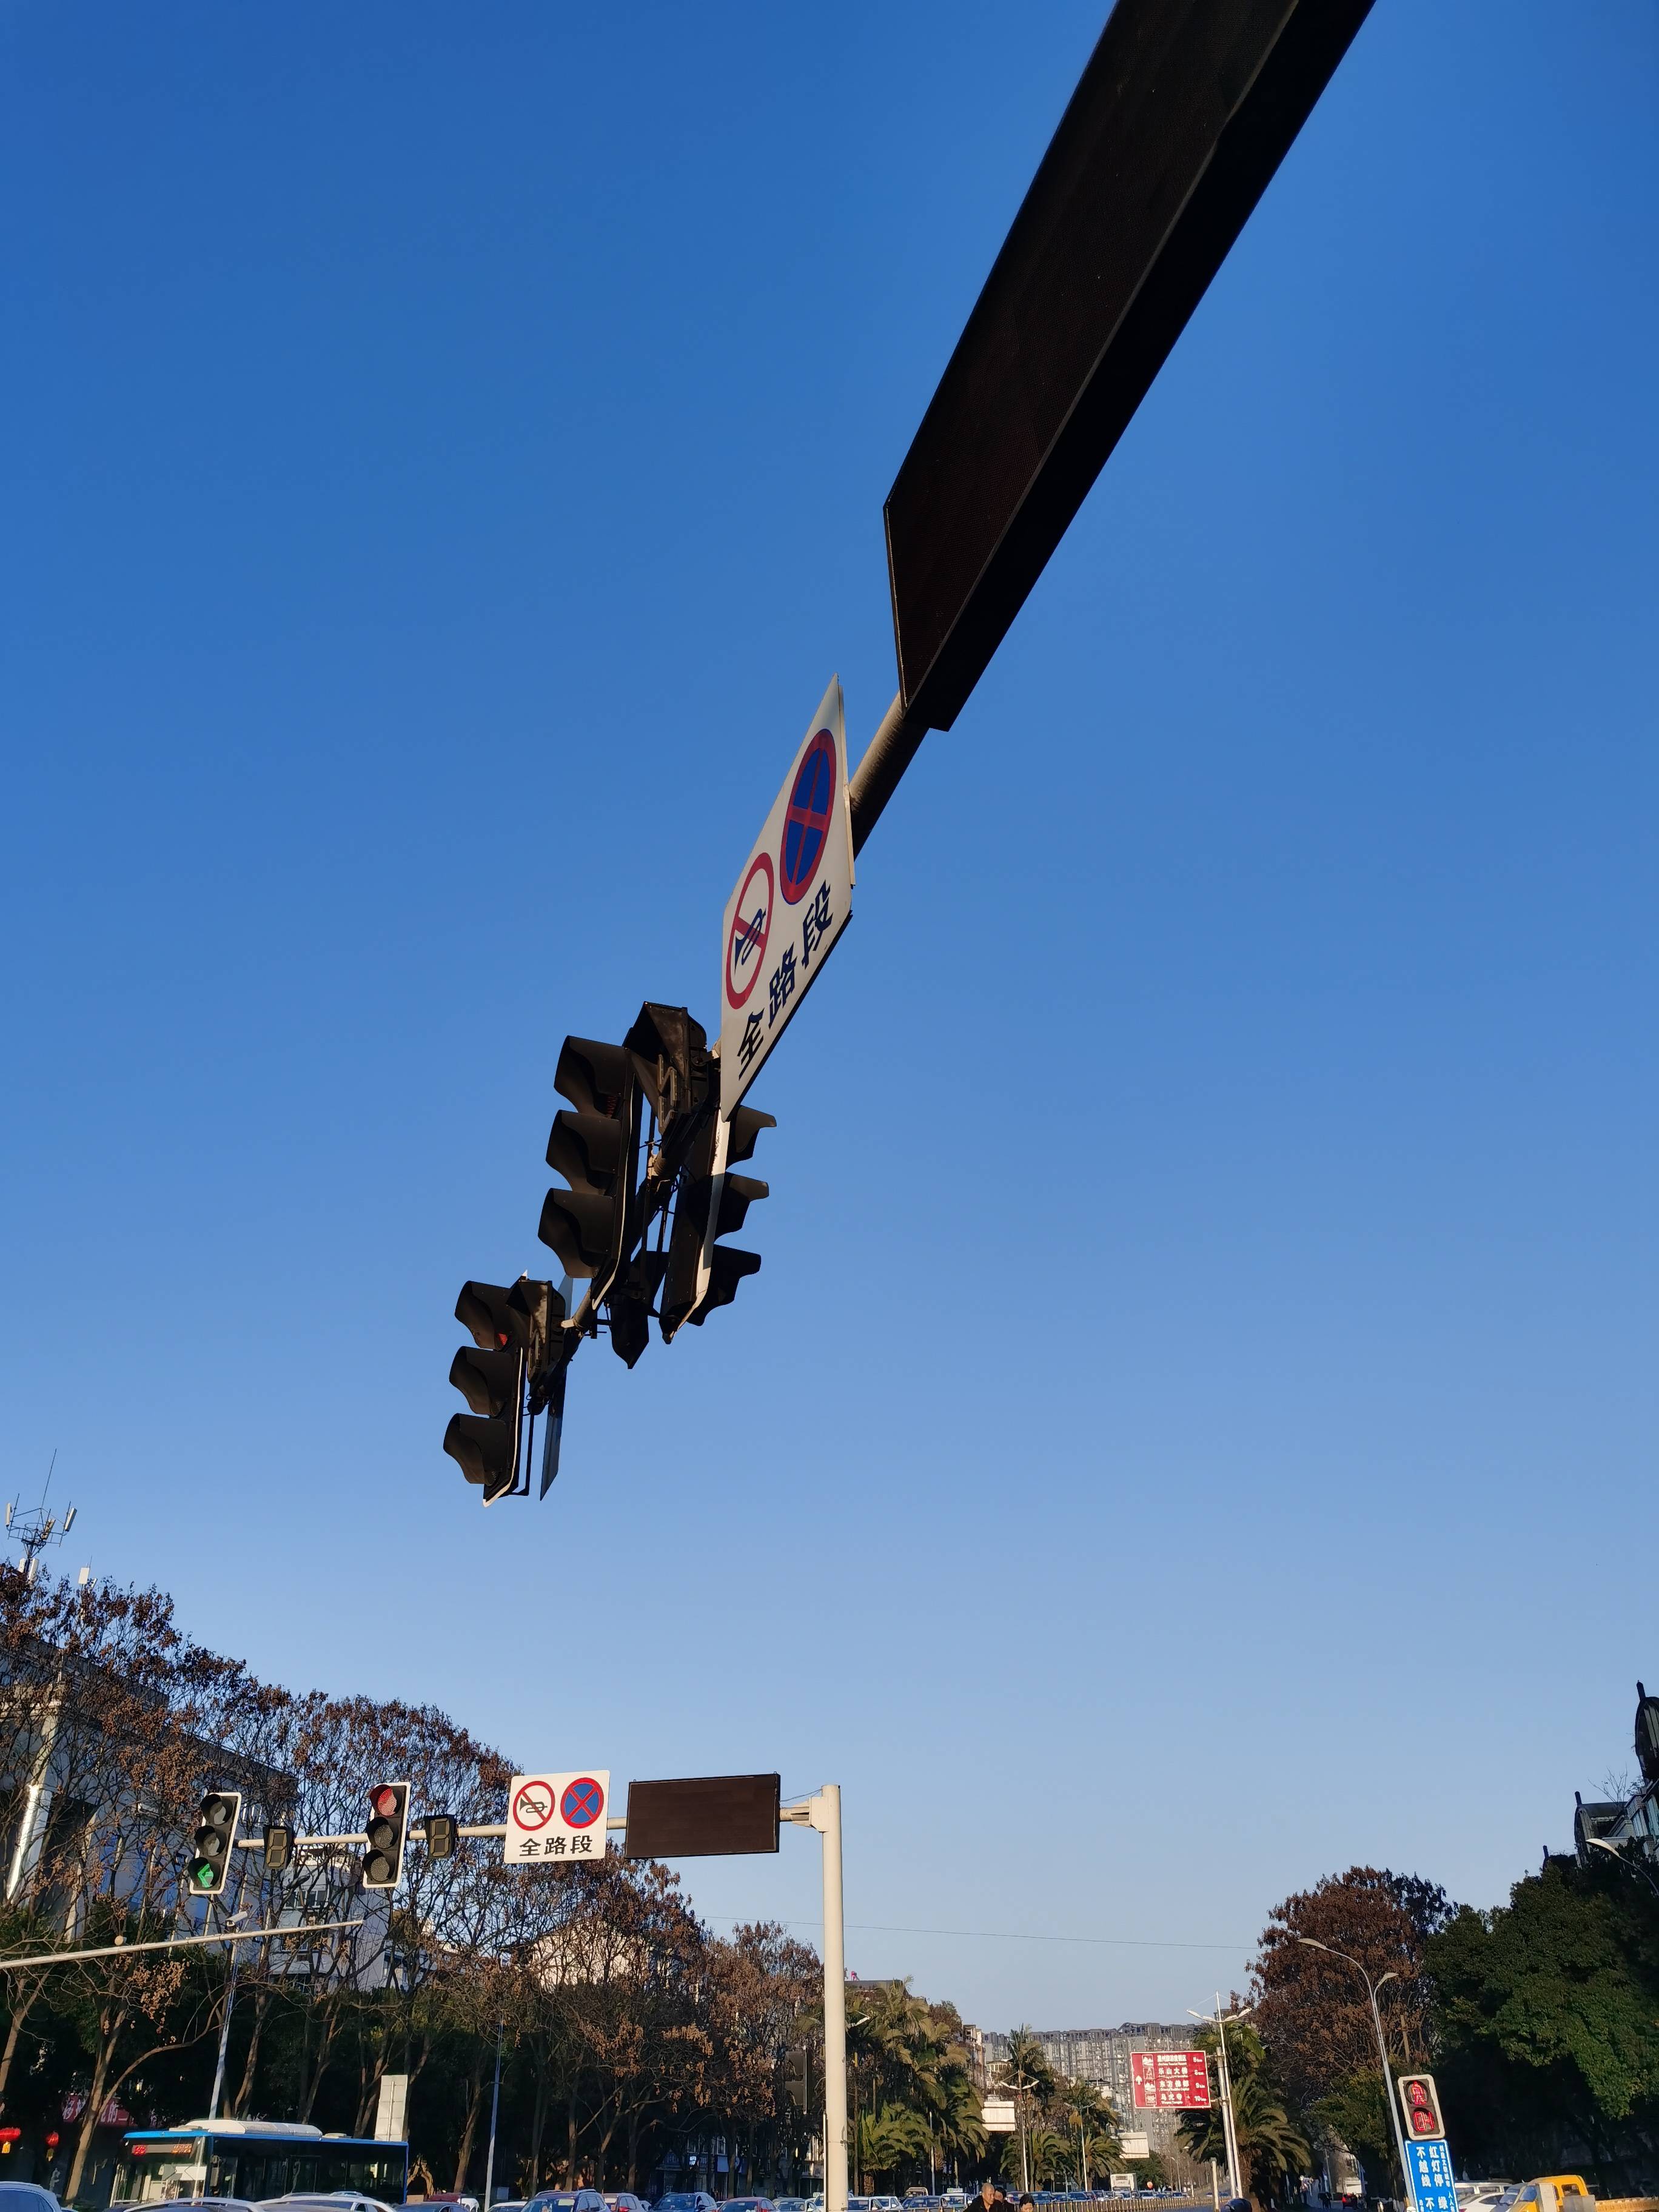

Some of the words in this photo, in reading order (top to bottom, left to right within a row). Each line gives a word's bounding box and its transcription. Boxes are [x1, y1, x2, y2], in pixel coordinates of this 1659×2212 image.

[738, 879, 833, 1081] 全路段
[519, 1835, 592, 1857] 全路段
[1429, 2145, 1444, 2187] 红灯停
